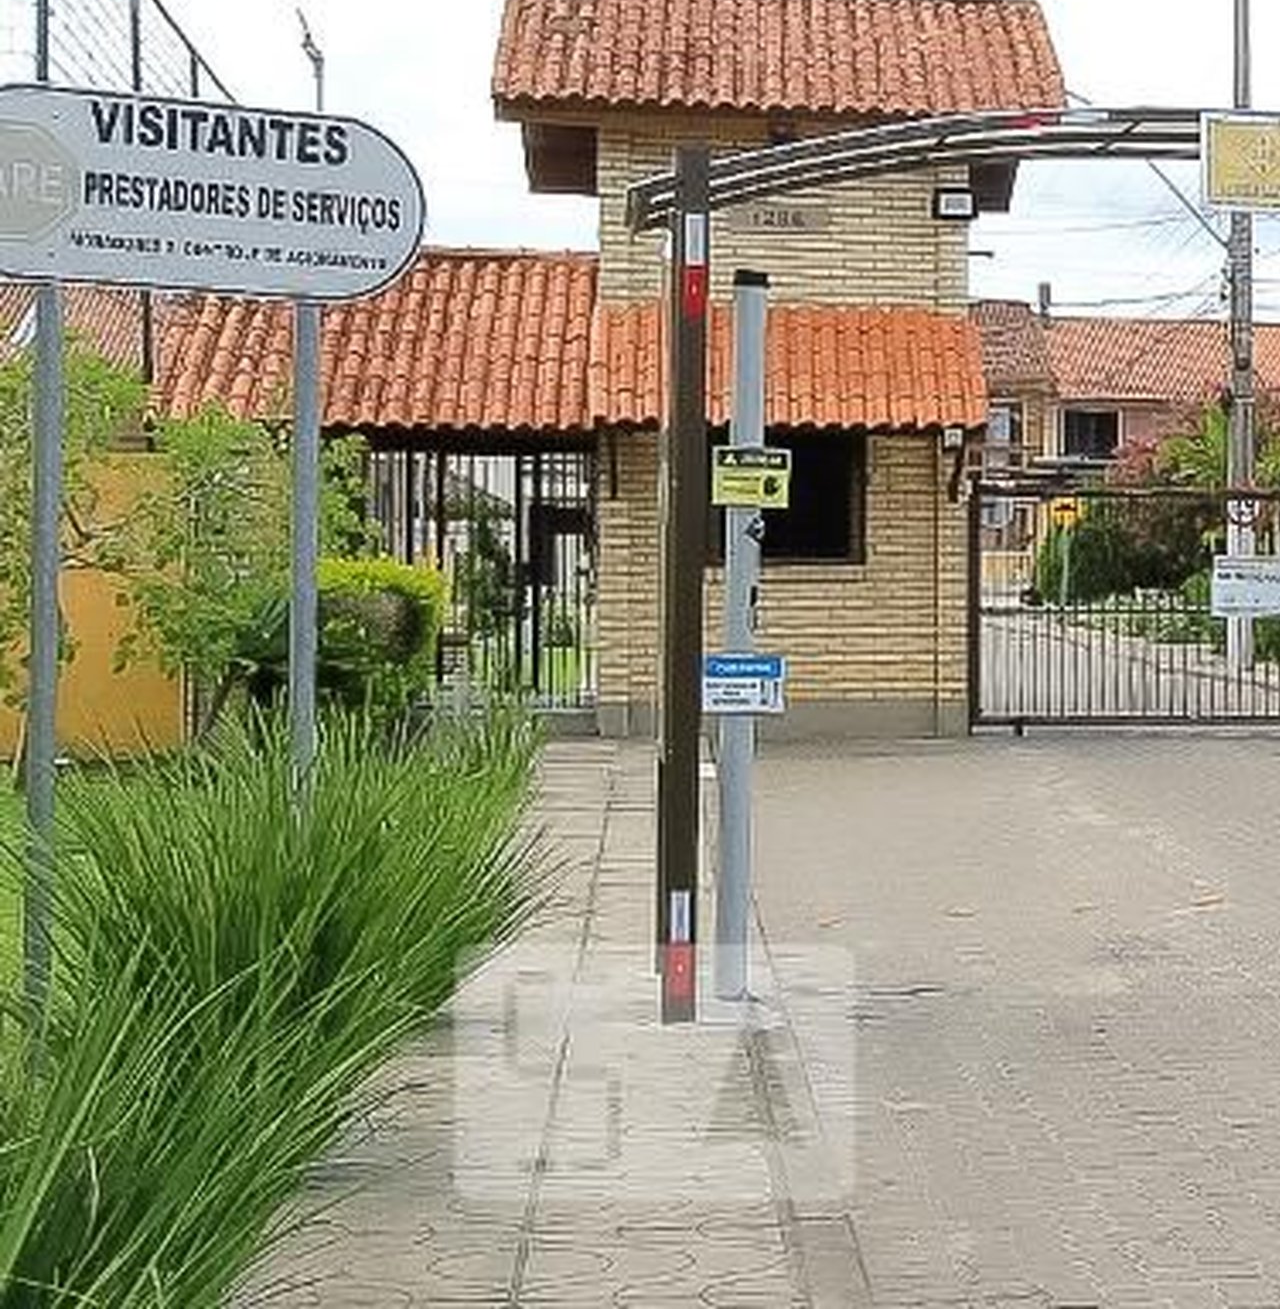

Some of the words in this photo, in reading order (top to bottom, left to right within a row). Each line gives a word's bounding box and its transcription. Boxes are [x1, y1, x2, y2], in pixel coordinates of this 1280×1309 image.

[90, 101, 348, 166] VISITANTES
[84, 171, 250, 218] PRESTADORES
[258, 188, 285, 220] DE
[292, 190, 401, 235] SERVIÇOS
